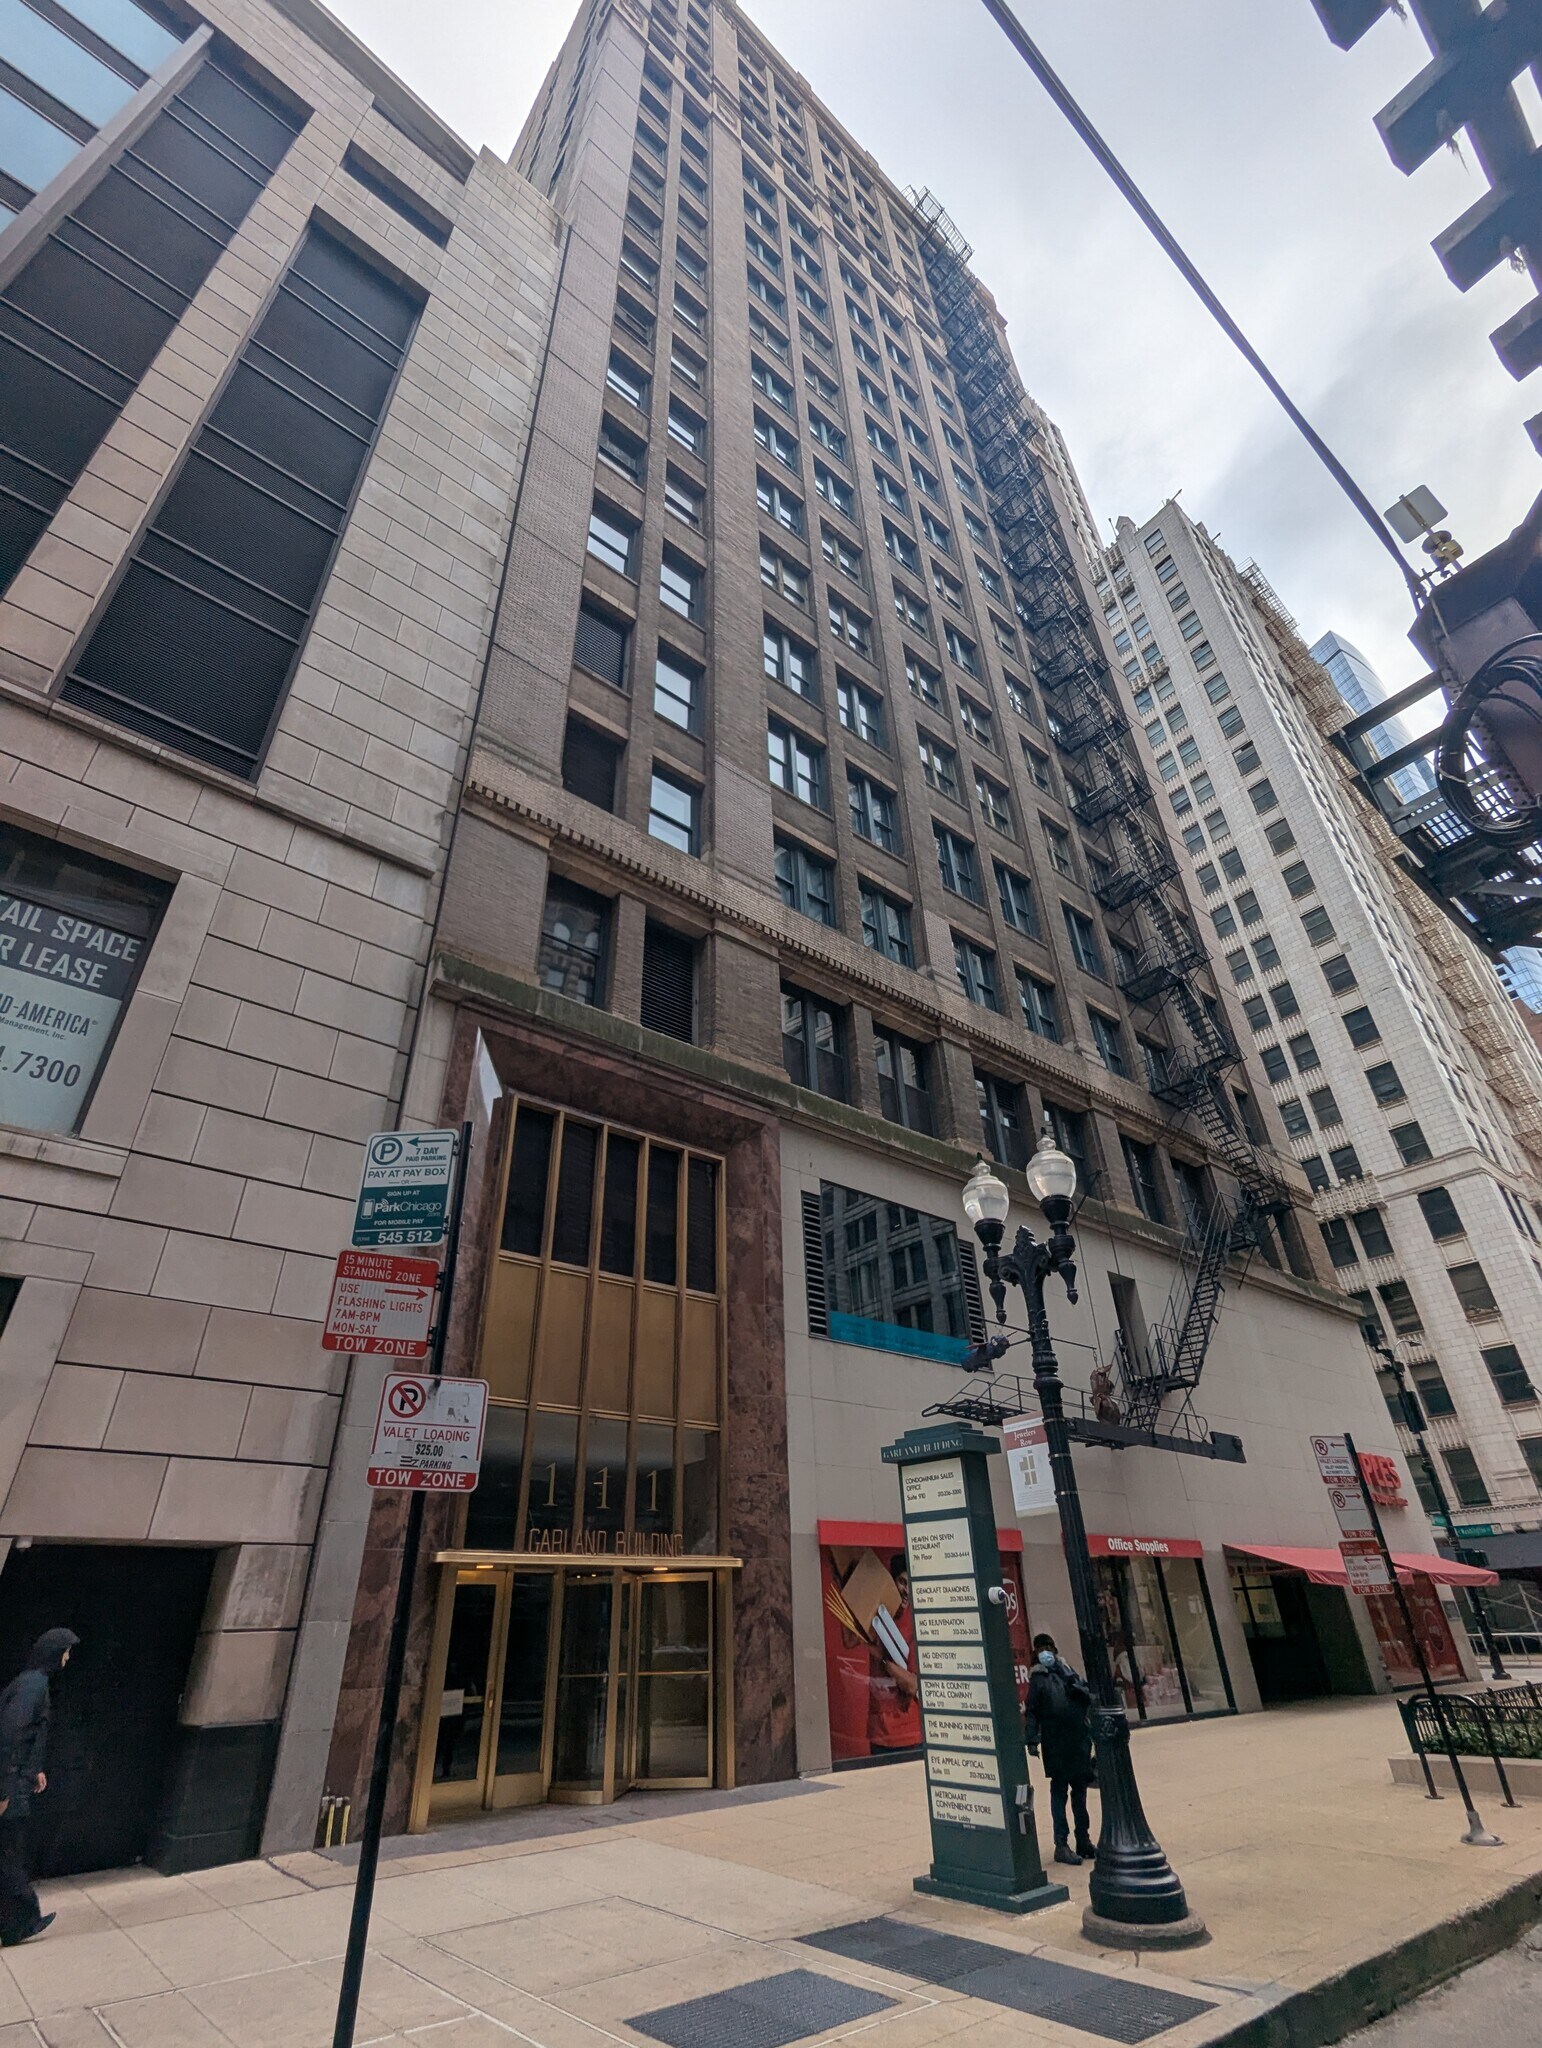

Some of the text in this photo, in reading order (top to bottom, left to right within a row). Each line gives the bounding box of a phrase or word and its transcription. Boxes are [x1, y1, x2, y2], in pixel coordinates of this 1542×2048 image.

[0, 895, 141, 962] AIL SPACE
[19, 942, 108, 988] LEASE
[52, 1031, 66, 1041] Inc.
[423, 1147, 439, 1155] DAY
[368, 1168, 446, 1178] PAY AT PAY BOX
[374, 1201, 442, 1213] ParkChicago
[377, 1231, 406, 1244] 545
[406, 1230, 433, 1243] 512
[345, 1254, 355, 1265] 15
[356, 1255, 394, 1269] MINUTE
[342, 1265, 422, 1283] STANDING ZONE
[340, 1283, 360, 1294] USE
[337, 1295, 424, 1313] FLASHING LIGHTS
[334, 1308, 381, 1322] 7AM-8PM
[332, 1321, 378, 1335] MON-SAT
[335, 1335, 417, 1355] TOW ZONE
[383, 1425, 470, 1442] VALET LOADING
[1014, 1428, 1037, 1441] Jewelers
[883, 1439, 962, 1459] GARLAND BUILDING
[1020, 1438, 1033, 1447] Row
[415, 1443, 444, 1457] $25.00
[419, 1459, 452, 1470] PARKING
[375, 1469, 467, 1488] TOW ZONE
[905, 1472, 954, 1485] CONDOMINIUM SALES
[528, 1528, 683, 1557] GARLAND BUILDING
[911, 1535, 928, 1543] HEAVEN
[939, 1533, 954, 1541] SEVEN
[912, 1542, 941, 1551] RESTAURANT
[1107, 1537, 1169, 1555] Office Supplies
[1372, 1585, 1389, 1593] ZONE
[919, 1618, 965, 1627] MG REJUVENATION
[932, 1652, 957, 1660] DENTISTRY
[924, 1681, 940, 1689] TOWN
[946, 1682, 971, 1690] COUNTRY
[925, 1690, 973, 1699] OPTICAL COMPANY
[928, 1720, 990, 1732] THE RUNNING INSTITUTE
[931, 1756, 984, 1769] EYE APPEAL OPTICAL
[934, 1791, 967, 1801] METROMART
[935, 1800, 992, 1815] CONVENIENCE STORE
[959, 1814, 971, 1822] Lobby
